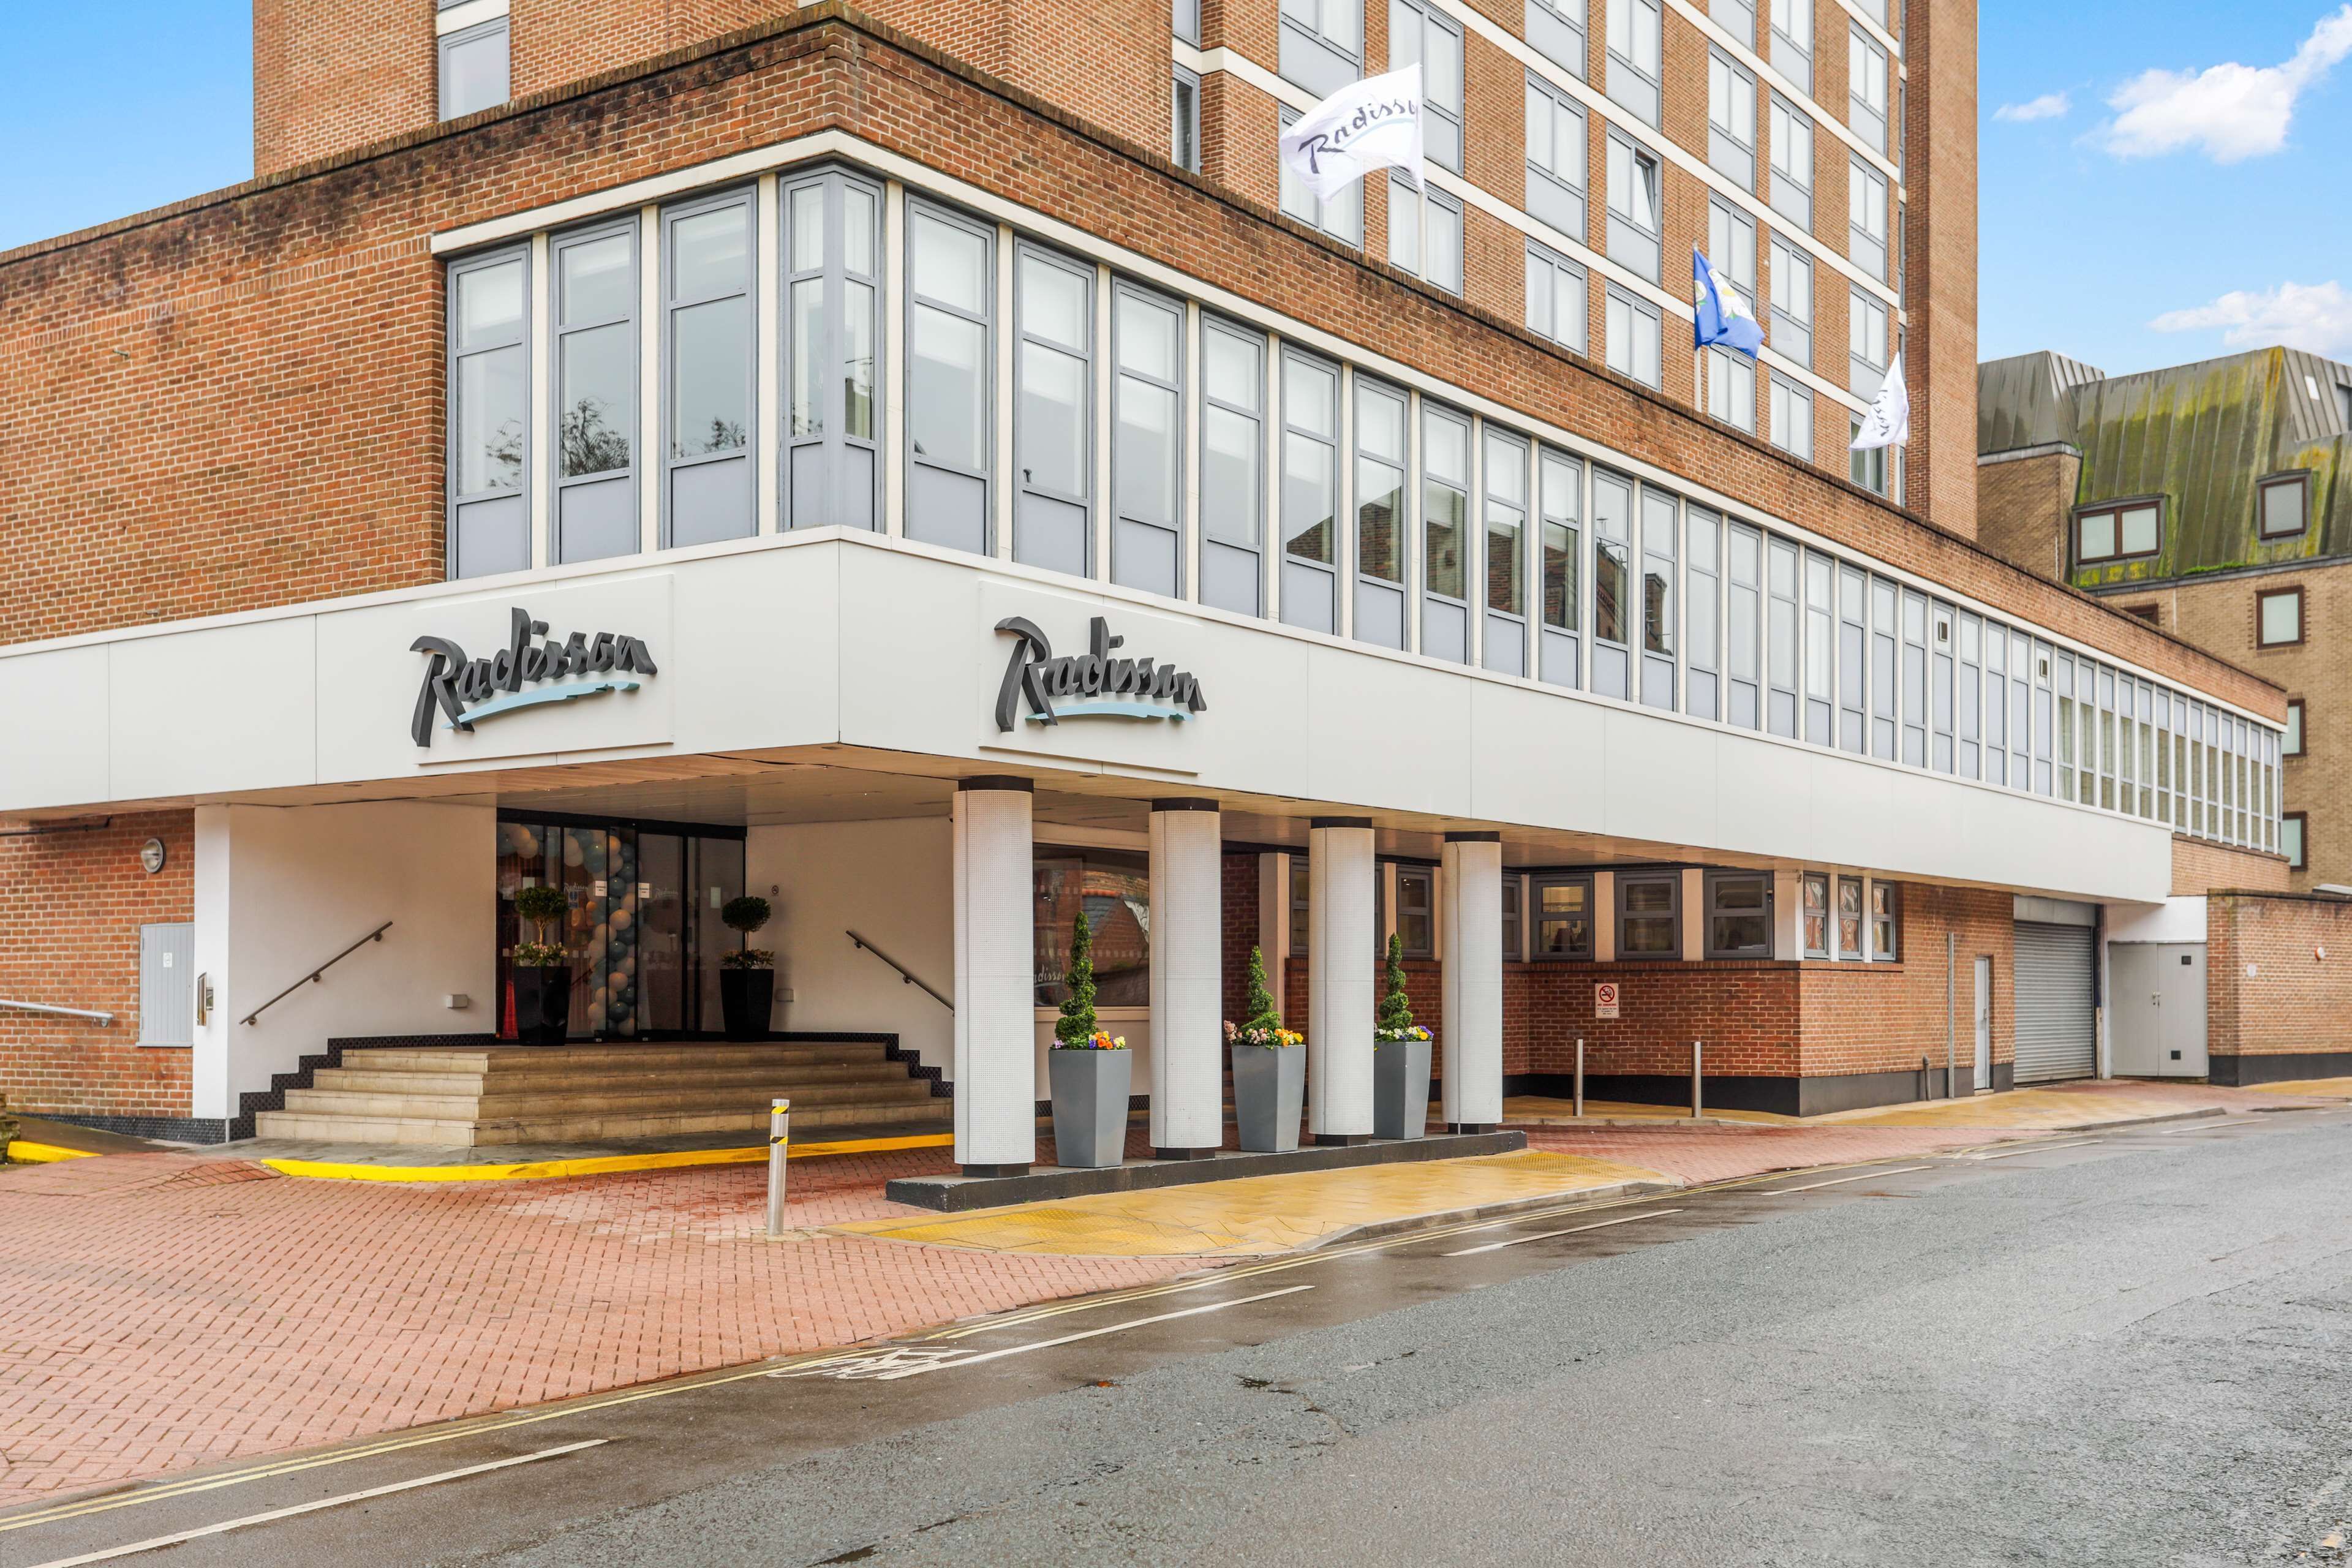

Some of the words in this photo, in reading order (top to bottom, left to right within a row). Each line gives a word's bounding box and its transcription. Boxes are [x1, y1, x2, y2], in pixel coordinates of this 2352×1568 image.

[1298, 99, 1419, 175] Radisso
[410, 606, 658, 747] Radisson
[994, 616, 1207, 733] Radisson
